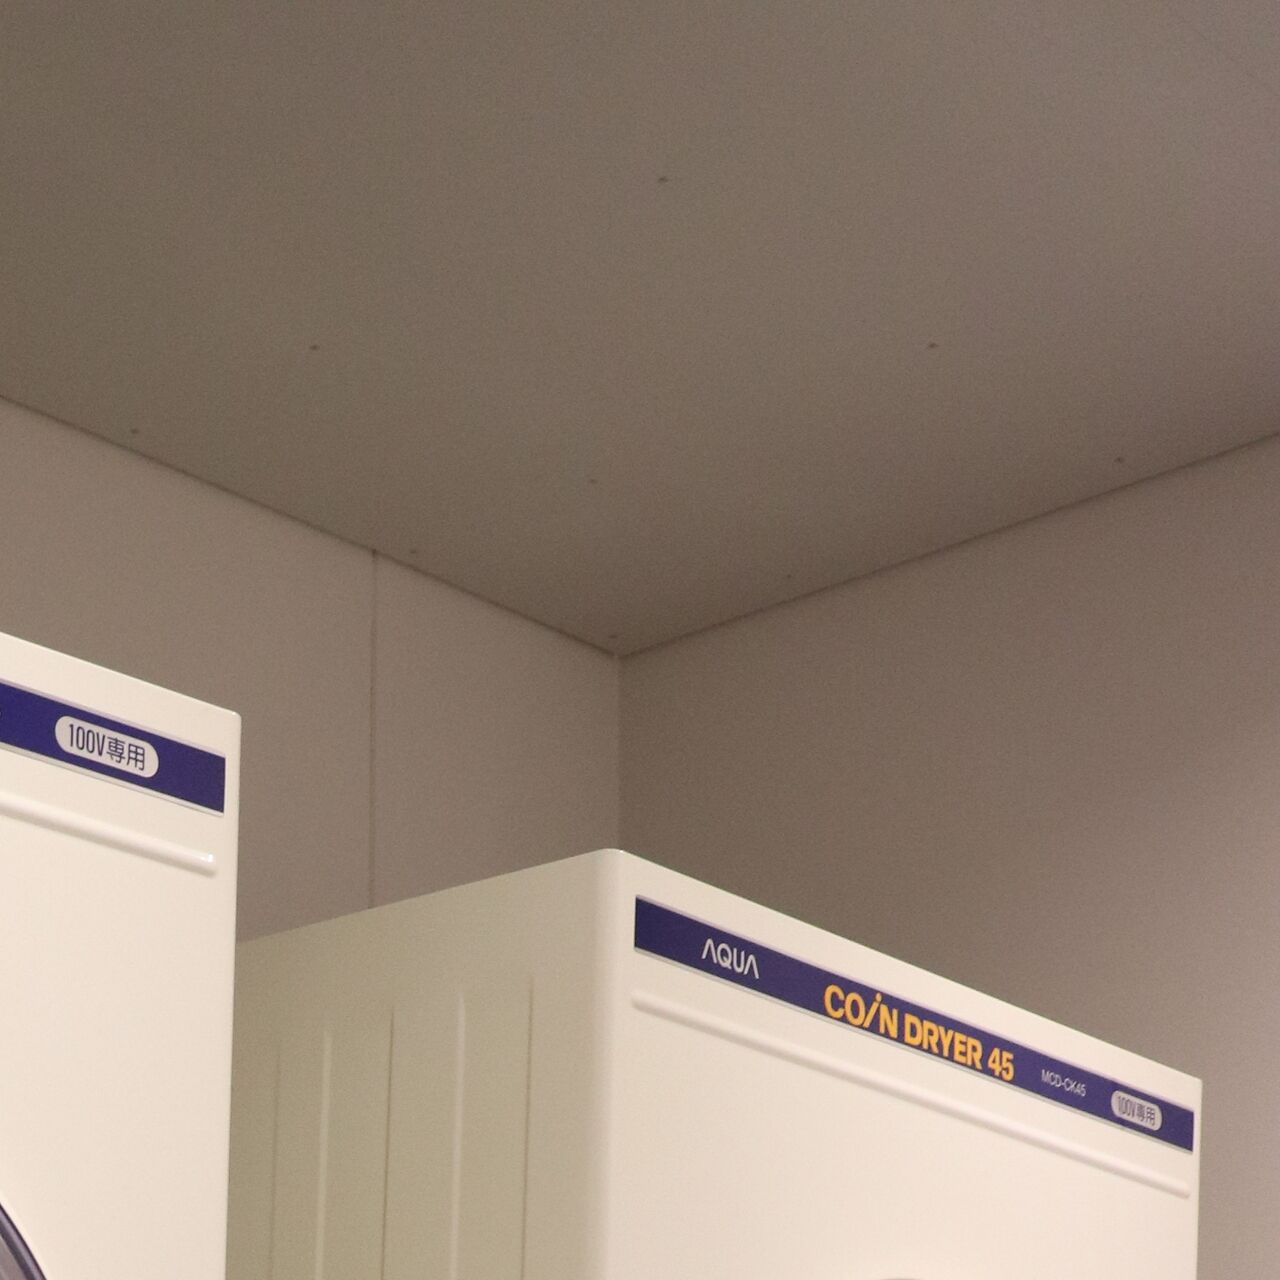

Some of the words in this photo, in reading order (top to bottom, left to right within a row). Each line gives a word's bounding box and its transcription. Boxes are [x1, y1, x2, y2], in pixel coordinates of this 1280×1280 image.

[66, 723, 146, 772] 100V専用
[701, 938, 759, 979] AQUA
[904, 1012, 983, 1070] DRYER
[988, 1047, 1015, 1082] 45
